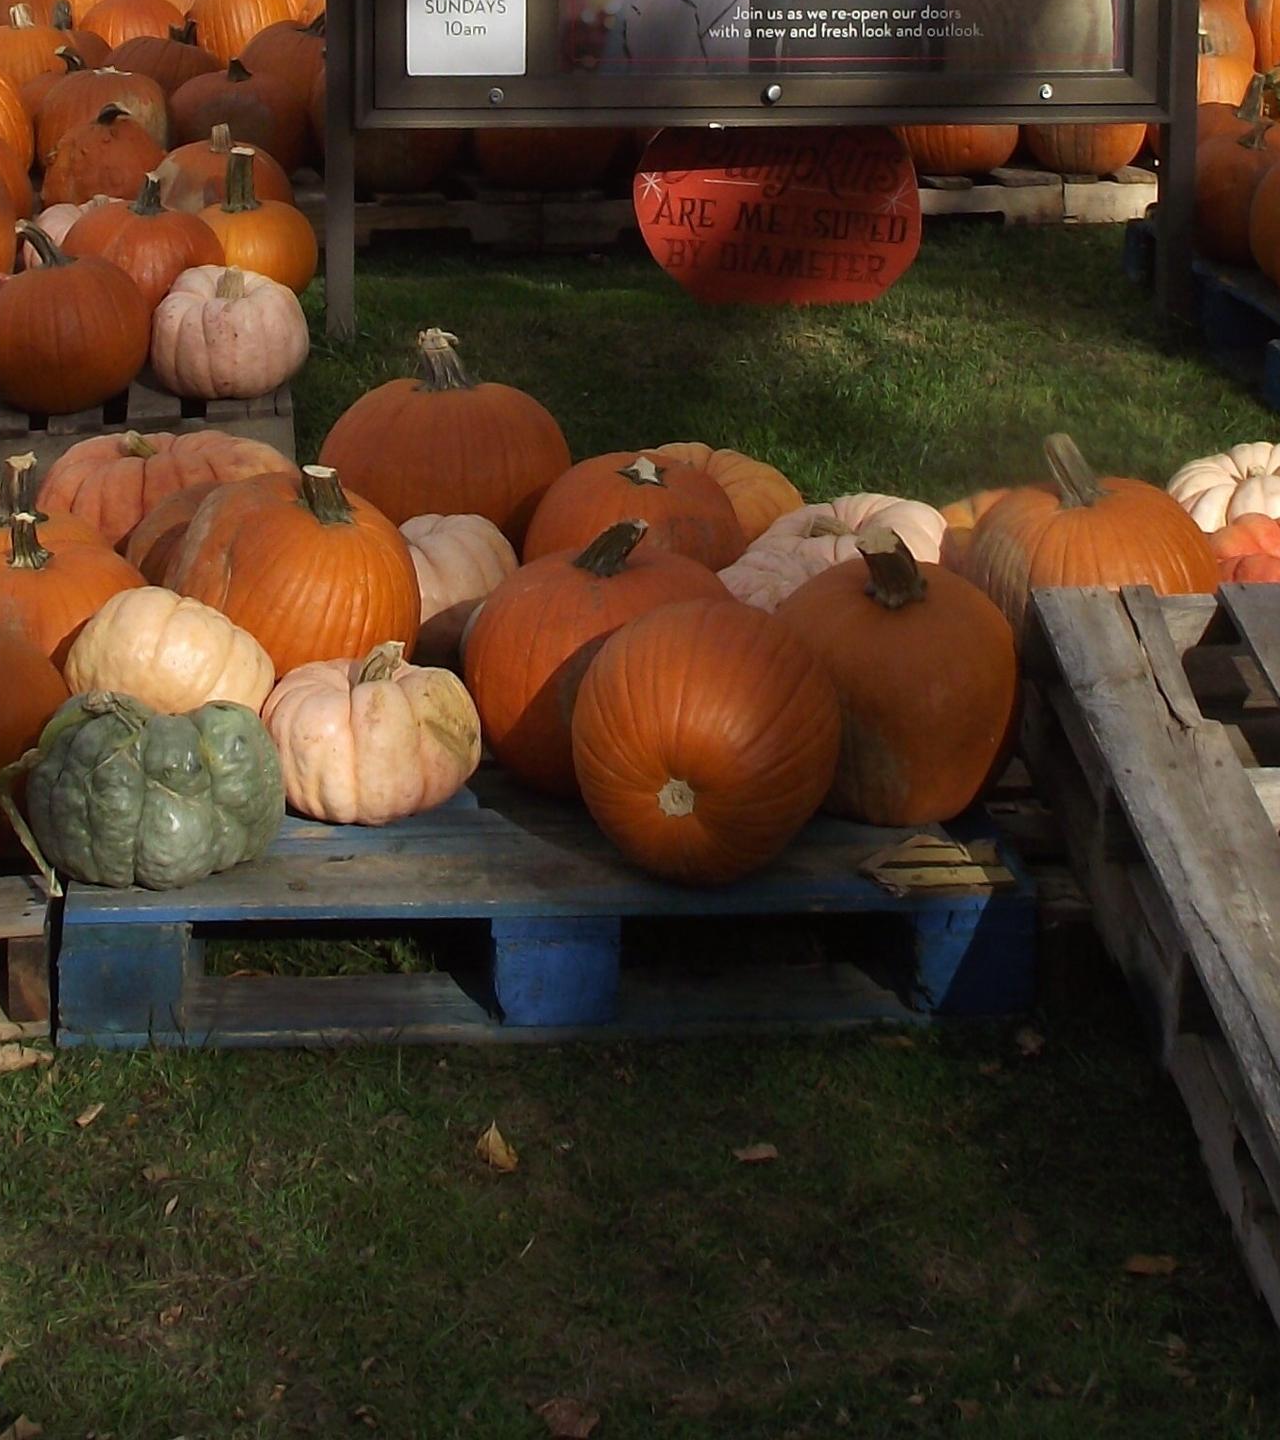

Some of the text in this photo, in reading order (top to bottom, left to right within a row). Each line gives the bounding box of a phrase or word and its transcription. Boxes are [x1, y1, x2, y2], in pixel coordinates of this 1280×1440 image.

[425, 0, 506, 14] SUNDAYS
[733, 5, 961, 23] Join us as we re-open our doors
[445, 21, 487, 36] 10am
[709, 23, 984, 38] with a new and fresh look and outlook.
[648, 191, 717, 236] ARE
[663, 237, 889, 284] BY DIAMETER
